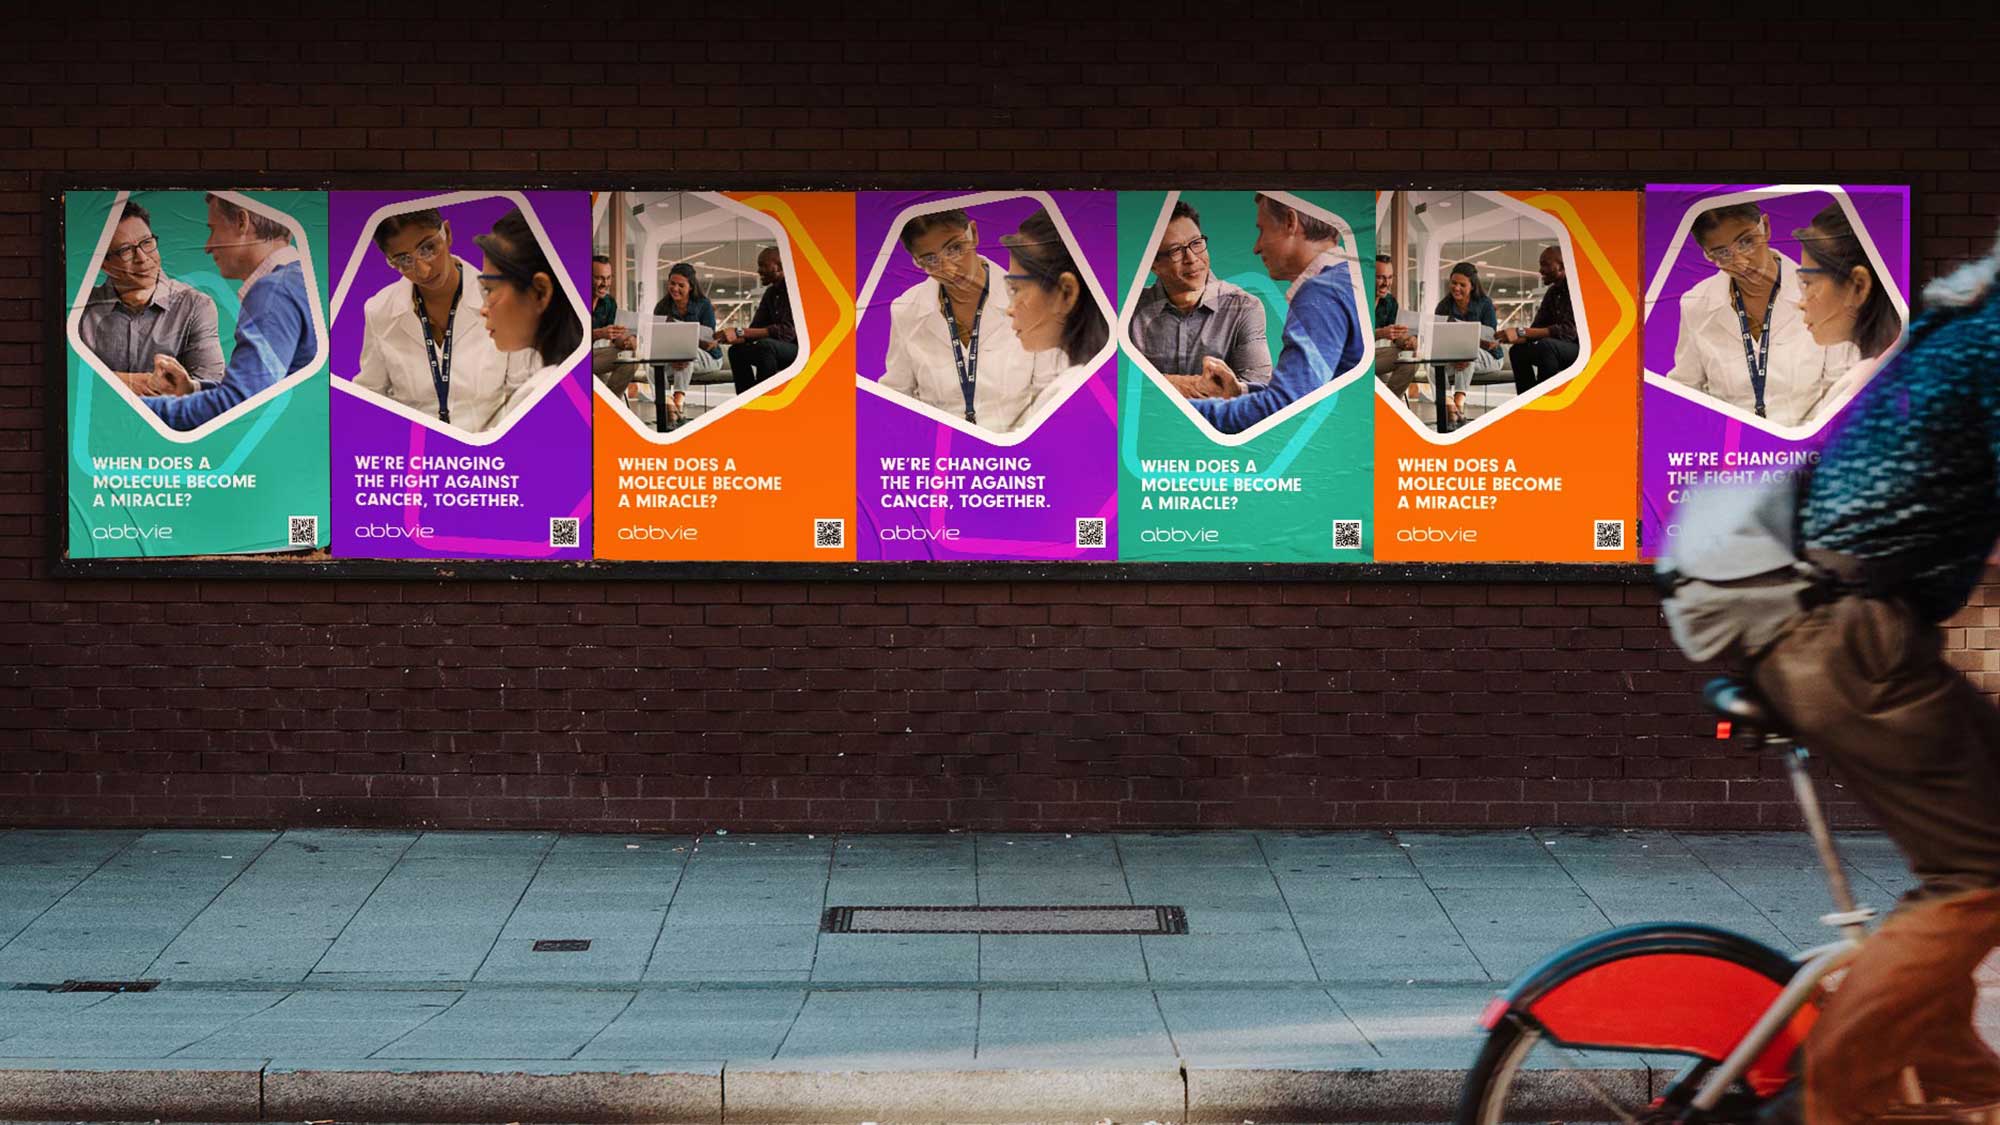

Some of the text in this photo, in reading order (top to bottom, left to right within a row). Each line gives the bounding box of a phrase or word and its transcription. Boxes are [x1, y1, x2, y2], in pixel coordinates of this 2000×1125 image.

[92, 456, 210, 470] WHEN DOES A
[354, 456, 506, 471] WE'RE CHANGING
[617, 458, 736, 472] WHEN DOES A
[880, 457, 1032, 471] WE'RE CHANGING
[1140, 459, 1257, 473] WHEN DOES A
[1397, 458, 1517, 473] WHEN DOES A
[1667, 451, 1821, 466] WE'RE CHANGING
[93, 475, 257, 489] MOLECULE BECOME
[354, 474, 520, 489] THE FIGHT AGAINST
[618, 476, 782, 491] MOLECULE BECOME
[880, 476, 1046, 490] THE FIGHT AGAINST
[1141, 477, 1302, 491] MOLECULE BECOME
[1397, 477, 1562, 492] MOLECULE BECOME
[1667, 471, 1698, 485] THE
[1704, 470, 1755, 485] FIGHT
[92, 493, 193, 507] A MIRACLE?
[355, 493, 524, 508] CANCER, TOGETHER.
[617, 494, 718, 508] A MIRACLE?
[880, 494, 1051, 510] CANCER, TOGETHER.
[1141, 496, 1239, 509] A MIRACLE?
[1397, 495, 1498, 510] A MIRACLE?
[92, 523, 173, 540] abbvie
[354, 523, 435, 538] abbvie
[617, 525, 698, 541] abbvie
[879, 525, 961, 541] abbvie
[1140, 527, 1219, 542] abbvie
[1396, 527, 1478, 543] abbvie
